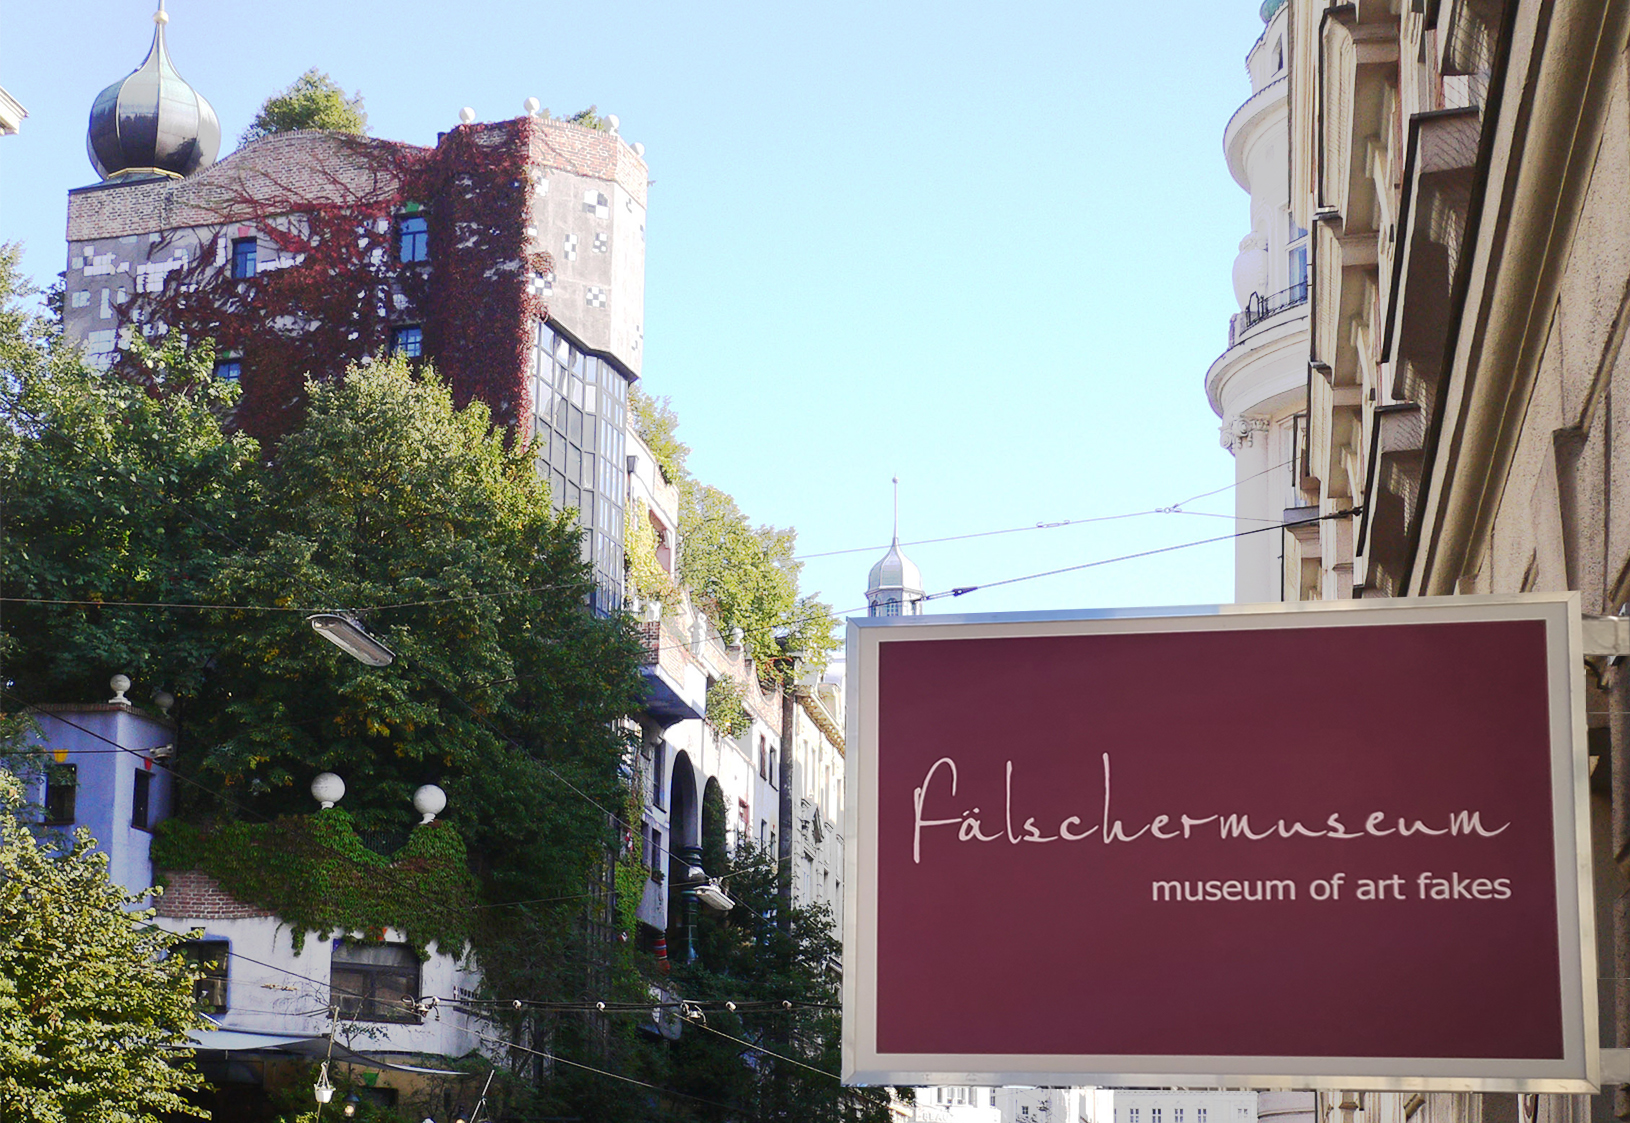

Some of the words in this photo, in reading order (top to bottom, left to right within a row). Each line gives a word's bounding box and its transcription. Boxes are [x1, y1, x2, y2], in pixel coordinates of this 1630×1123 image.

[913, 752, 1510, 864] fälschermuseum
[1152, 880, 1296, 902] museum
[1309, 873, 1346, 901] of
[1356, 874, 1406, 900] art
[1417, 872, 1512, 900] fakes
